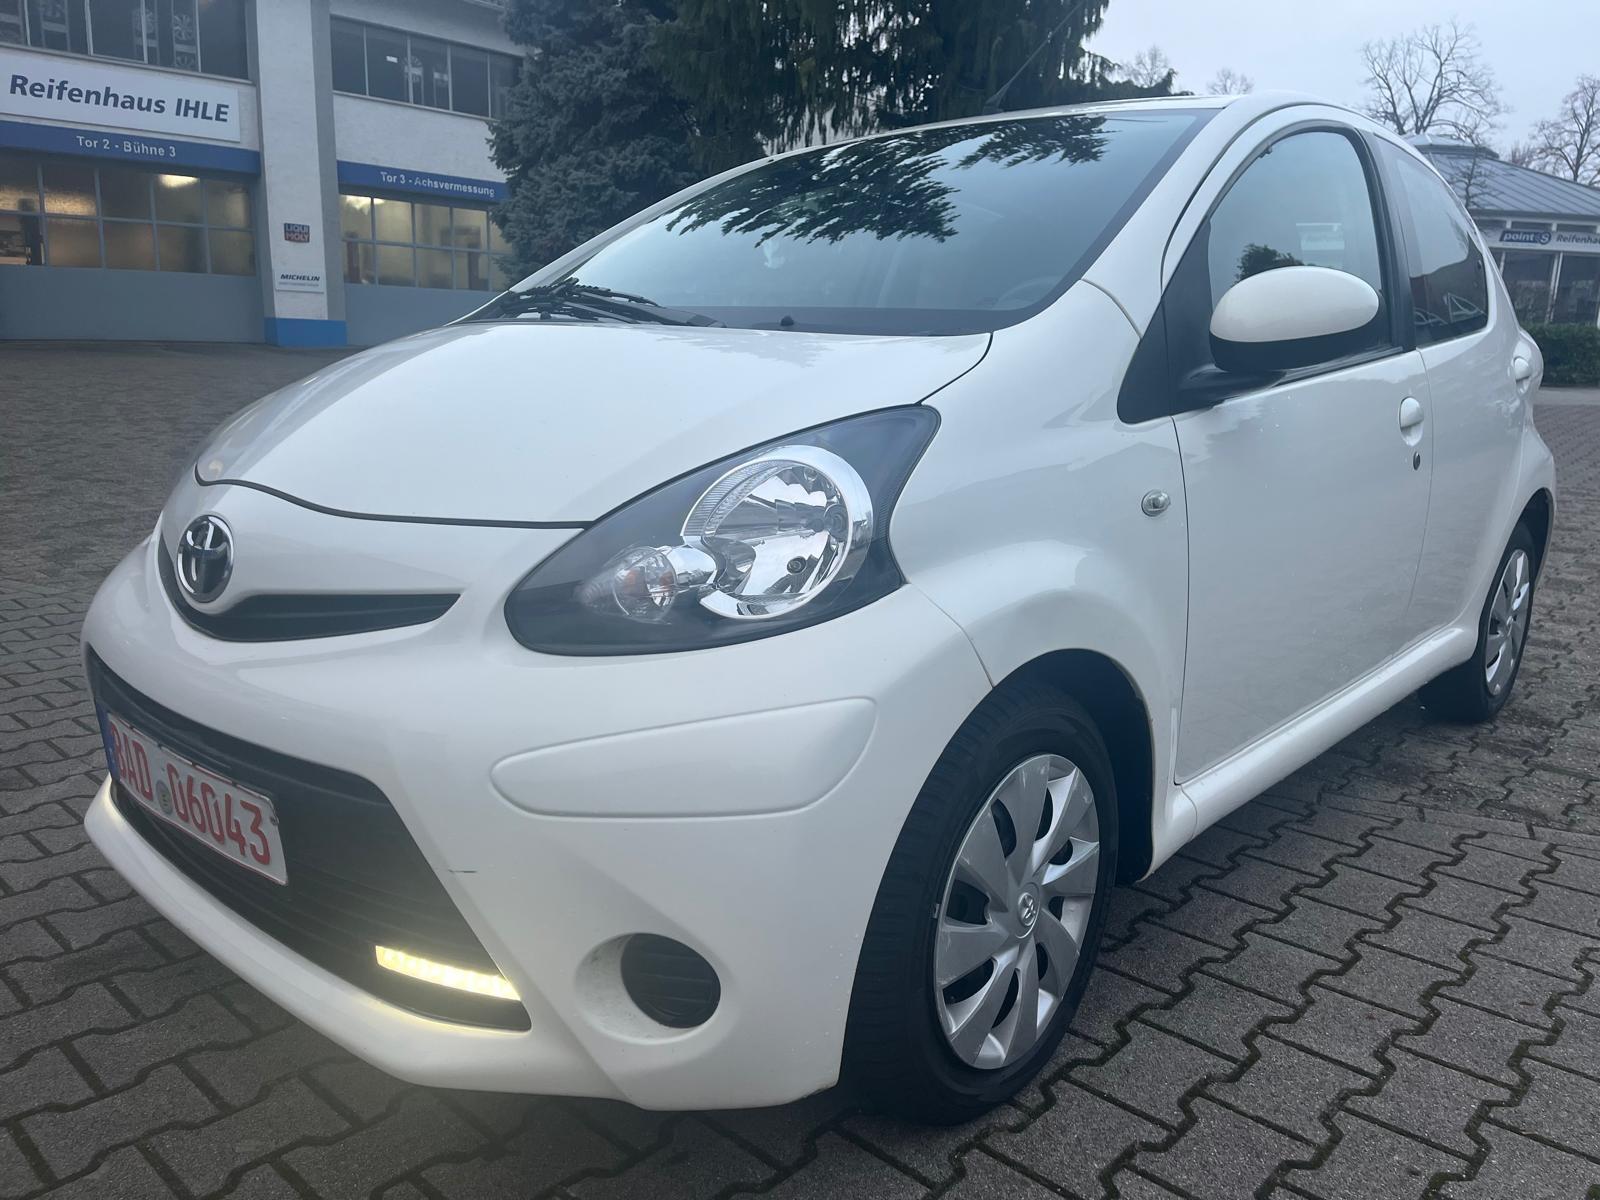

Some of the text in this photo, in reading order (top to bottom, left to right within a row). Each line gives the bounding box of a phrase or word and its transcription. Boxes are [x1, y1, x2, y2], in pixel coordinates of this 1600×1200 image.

[9, 74, 229, 122] Reifenhaus IHLE
[76, 136, 98, 149] Tor
[103, 138, 110, 149] 2
[123, 141, 165, 156] Bühne
[169, 146, 176, 157] 3
[380, 171, 396, 183] Tor
[400, 174, 406, 184] 3
[414, 176, 495, 198] Achsvermessung
[1503, 231, 1549, 243] point S
[280, 273, 320, 282] MICHELIN
[166, 763, 271, 865] 06043
